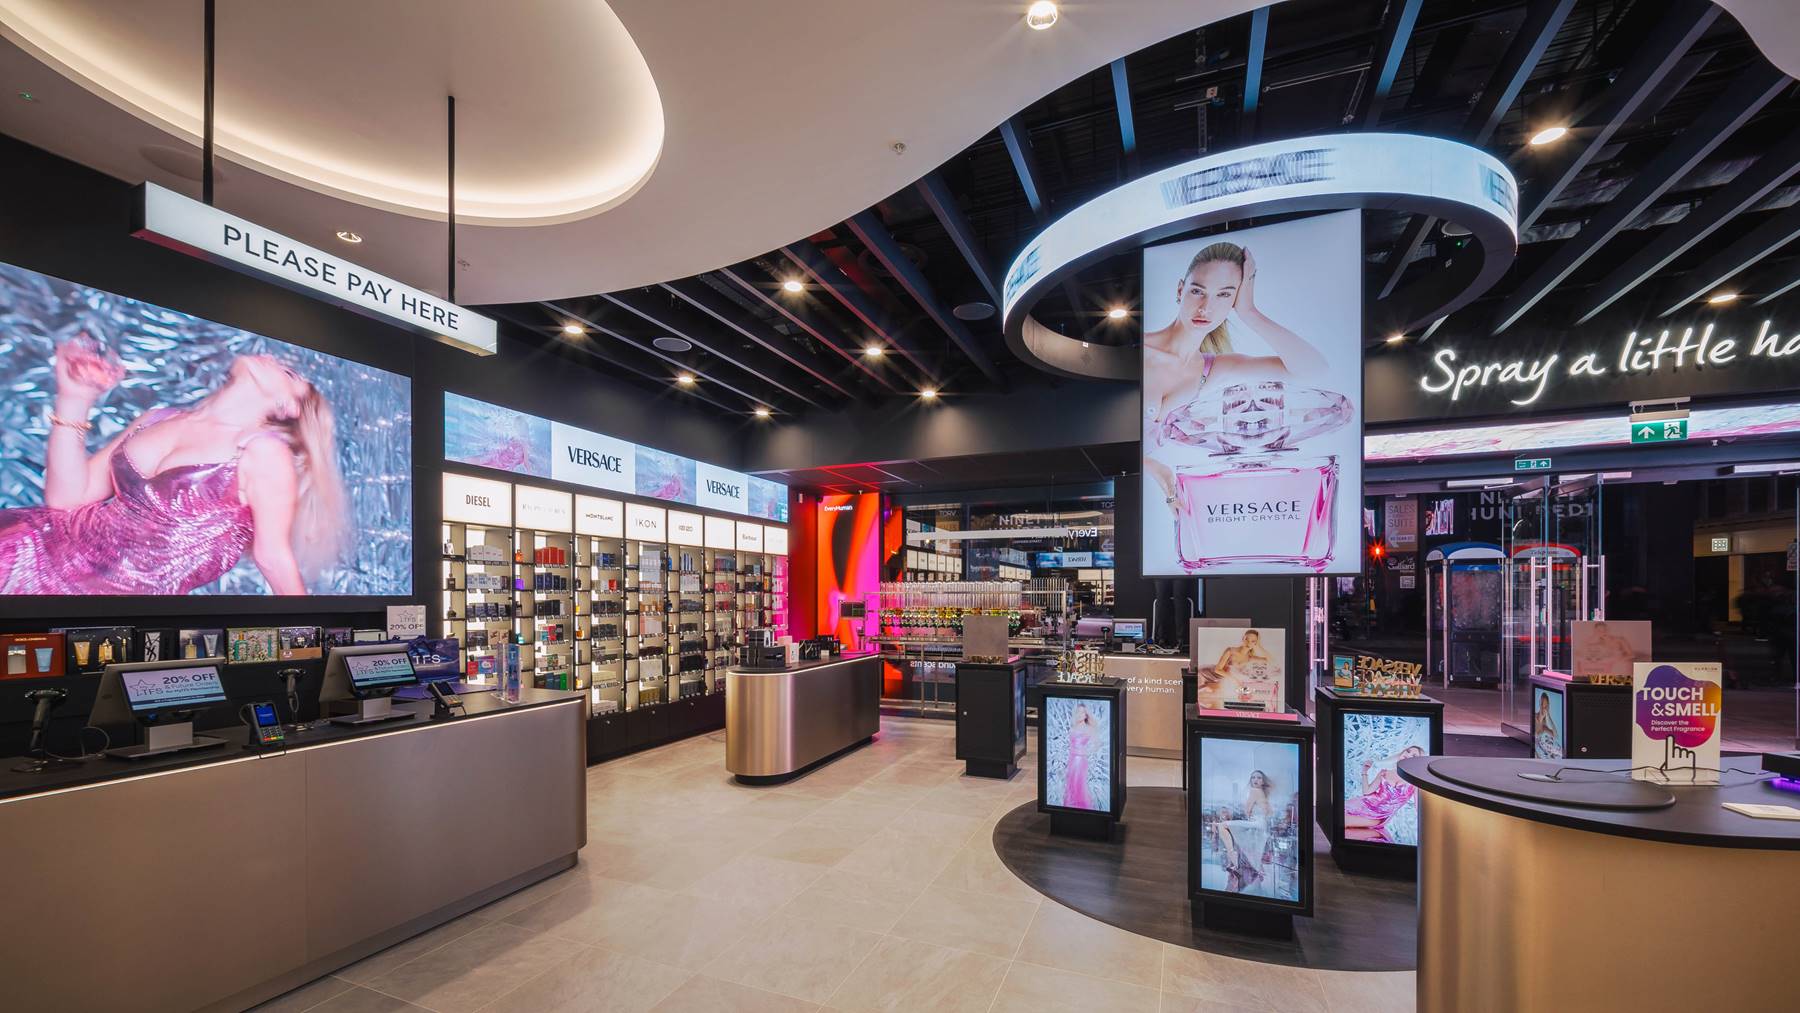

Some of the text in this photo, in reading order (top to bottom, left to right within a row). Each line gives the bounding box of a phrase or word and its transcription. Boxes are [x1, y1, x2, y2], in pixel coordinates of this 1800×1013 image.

[223, 224, 459, 330] PLEASE PAY HERE
[1420, 349, 1559, 405] Spray
[1569, 353, 1606, 376] a
[1618, 322, 1738, 373] little
[567, 445, 622, 474] VERSACE
[705, 479, 740, 499] VERSACE
[465, 494, 491, 508] DIESEL
[1206, 500, 1301, 516] VERSACE
[1207, 514, 1301, 524] BRIGHT CRYSTAL
[372, 657, 407, 667] 20% OFF
[412, 654, 441, 665] TFS
[162, 672, 216, 685] 20% OFF
[1144, 677, 1162, 685] kind
[1589, 674, 1633, 686] VERSA
[1126, 685, 1144, 693] very
[1641, 687, 1704, 701] TOUCH
[1651, 702, 1721, 717] &SMELL
